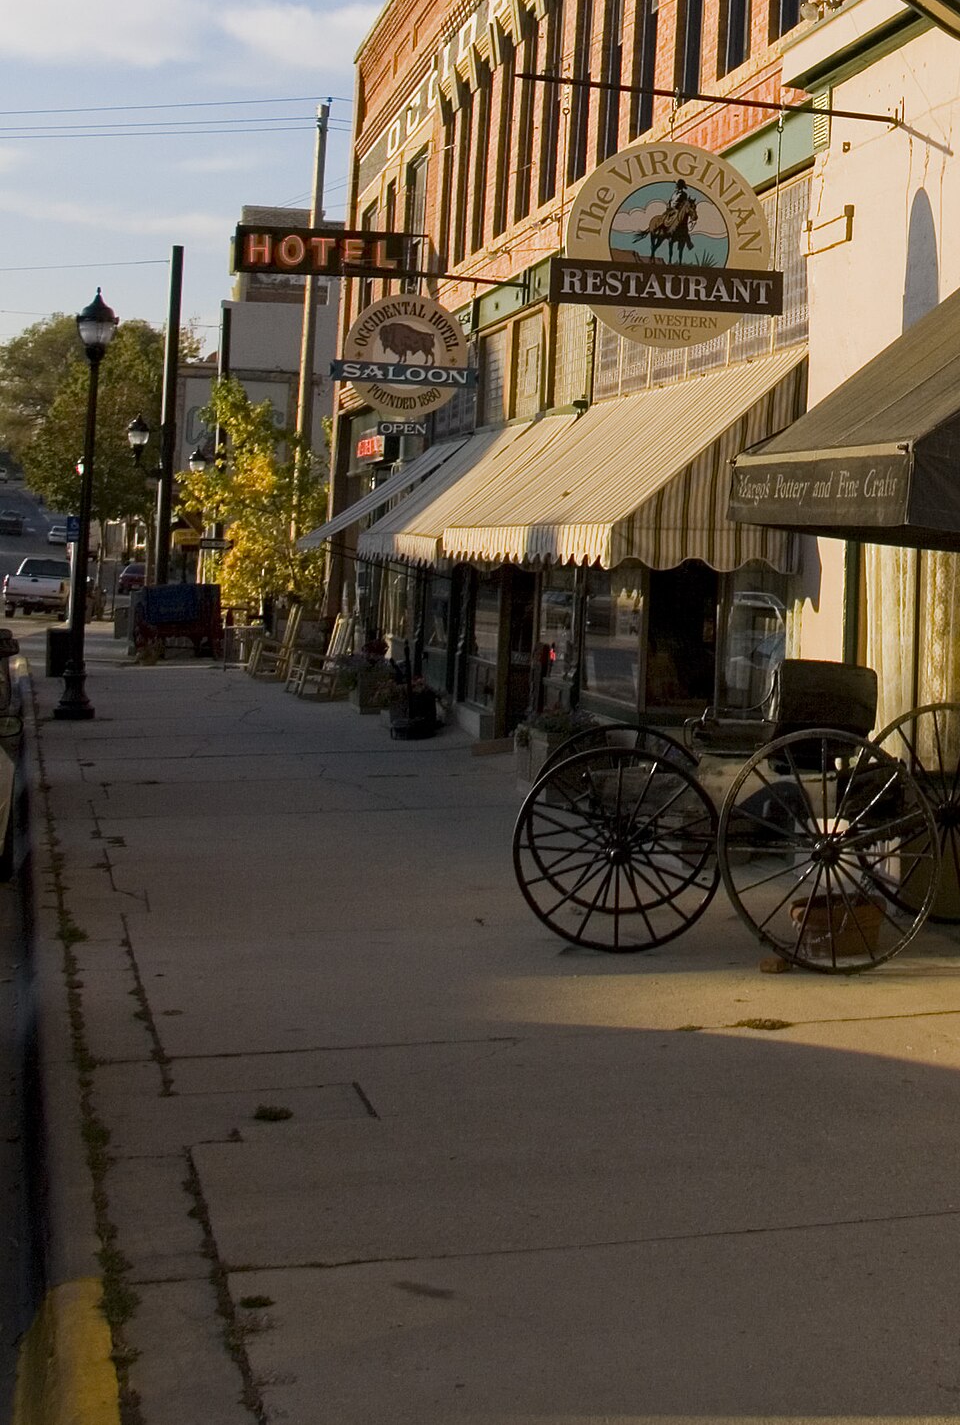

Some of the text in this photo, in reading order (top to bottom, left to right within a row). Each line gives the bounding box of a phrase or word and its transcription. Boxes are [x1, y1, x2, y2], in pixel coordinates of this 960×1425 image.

[576, 150, 764, 254] The VIRGINIAN
[246, 234, 398, 267] HOTEL
[560, 267, 773, 305] RESTAURANT
[354, 301, 460, 352] OCCIDENTAL HOTEL
[615, 308, 718, 329] Fine WESTERN
[644, 328, 691, 341] DINING
[342, 363, 469, 384] SALOON
[366, 383, 442, 410] FOUNDED 1880
[380, 423, 427, 435] OPEN
[737, 466, 898, 505] Margo's Pottery and Fine Crafts
